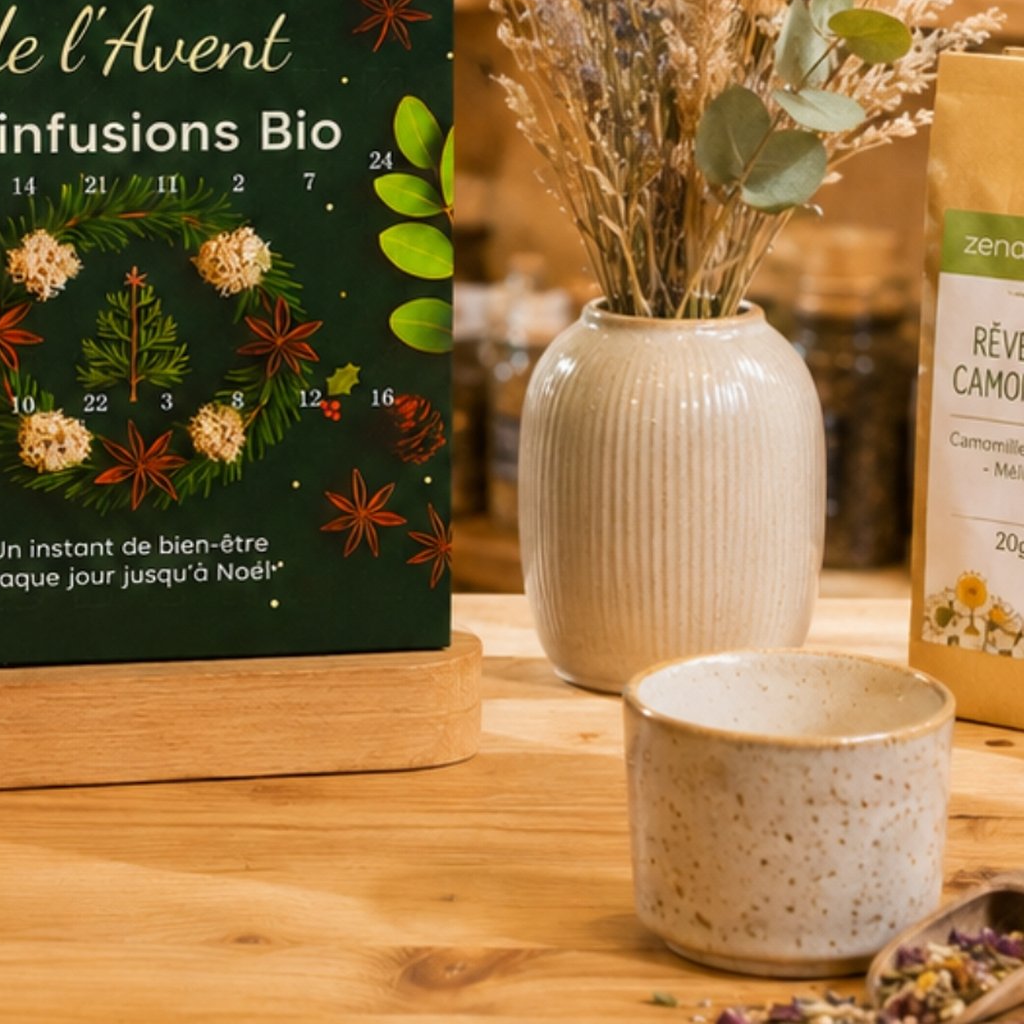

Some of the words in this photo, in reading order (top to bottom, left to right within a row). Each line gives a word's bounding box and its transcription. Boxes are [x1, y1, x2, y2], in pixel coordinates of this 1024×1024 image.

[60, 3, 293, 77] l'Avent
[260, 109, 342, 152] Bio
[369, 151, 393, 170] 24
[12, 177, 36, 195] 14
[84, 175, 107, 194] 21
[157, 175, 178, 193] 11
[232, 174, 245, 192] 2
[303, 172, 316, 191] 7
[953, 364, 1024, 402] CAMO
[12, 396, 36, 414] 10
[83, 393, 108, 412] 22
[161, 393, 173, 410] 3
[232, 391, 244, 409] 8
[299, 389, 322, 408] 12
[371, 388, 394, 407] 16
[29, 538, 114, 558] instant
[121, 536, 152, 556] de
[158, 534, 269, 555] bien-être
[66, 567, 115, 591] jour
